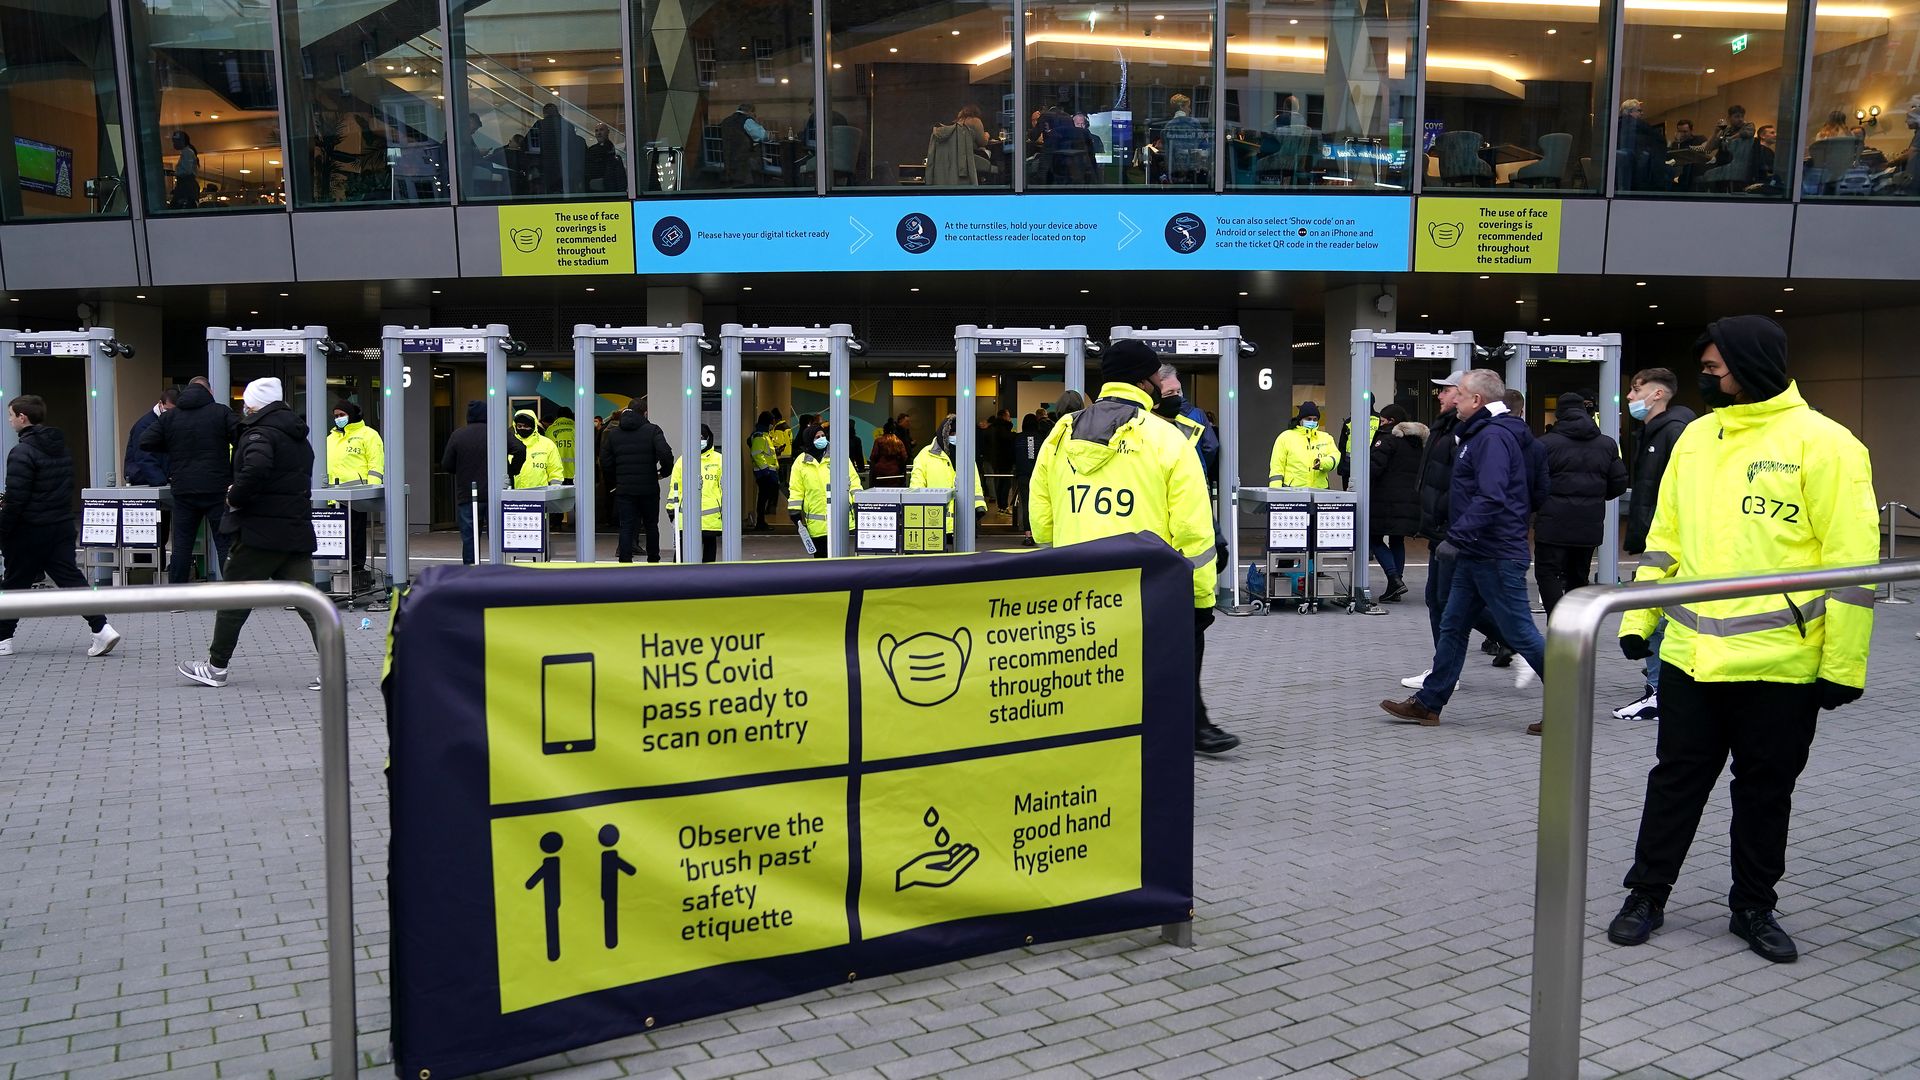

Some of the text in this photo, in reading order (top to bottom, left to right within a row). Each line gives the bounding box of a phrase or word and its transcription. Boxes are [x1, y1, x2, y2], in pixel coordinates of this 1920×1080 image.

[1425, 122, 1443, 130] COYS
[554, 210, 620, 222] The use of face
[1215, 216, 1231, 225] You
[1246, 216, 1264, 225] also
[1264, 216, 1288, 225] select
[1288, 216, 1313, 226] 'Show
[1313, 216, 1335, 226] code'
[1334, 218, 1346, 226] on
[1345, 218, 1357, 226] an
[1479, 207, 1548, 218] The use of face
[555, 222, 607, 234] coverings is
[697, 229, 830, 241] Please have your digital ticket ready
[944, 221, 1098, 232] At the turnstiles, hold your device above
[1215, 227, 1247, 237] Android
[1257, 228, 1282, 237] select
[1282, 228, 1296, 237] the
[1331, 228, 1358, 238] iPhone
[1359, 228, 1374, 238] and
[1477, 231, 1543, 241] recommended
[1478, 219, 1533, 232] coverings is
[556, 233, 617, 244] recommended
[944, 233, 958, 242] the
[958, 233, 1004, 242] contactless
[1004, 232, 1030, 242] reader
[1031, 232, 1060, 242] located
[1072, 234, 1087, 244] top
[1234, 239, 1248, 248] the
[1249, 240, 1272, 249] ticket
[1272, 239, 1285, 249] QR
[1286, 240, 1305, 249] code
[1306, 240, 1314, 249] in
[1314, 240, 1328, 249] the
[1329, 240, 1355, 249] reader
[1355, 240, 1379, 249] below
[1477, 242, 1530, 255] throughout
[556, 245, 606, 258] throughout
[557, 256, 609, 267] the stadium
[1476, 254, 1532, 265] the stadium
[701, 365, 716, 388] 6
[1258, 368, 1273, 390] 6
[1067, 484, 1135, 517] 1769
[1741, 495, 1800, 523] 0372
[988, 589, 1123, 619] The use of face
[986, 616, 1096, 645] coverings is
[641, 632, 766, 662] Have your
[988, 638, 1118, 672] recommended
[642, 654, 774, 691] NHS Covid
[989, 663, 1125, 698] throughout the
[642, 687, 808, 729] pass ready to
[989, 698, 1065, 724] stadium
[642, 719, 809, 753] scan on entry
[1014, 784, 1097, 816] Maintain
[678, 812, 824, 850] Observe the
[1012, 806, 1111, 850] good hand
[680, 840, 817, 882] 'brush past'
[1013, 844, 1088, 876] hygiene
[682, 884, 757, 913] safety
[681, 908, 795, 943] etiquette
